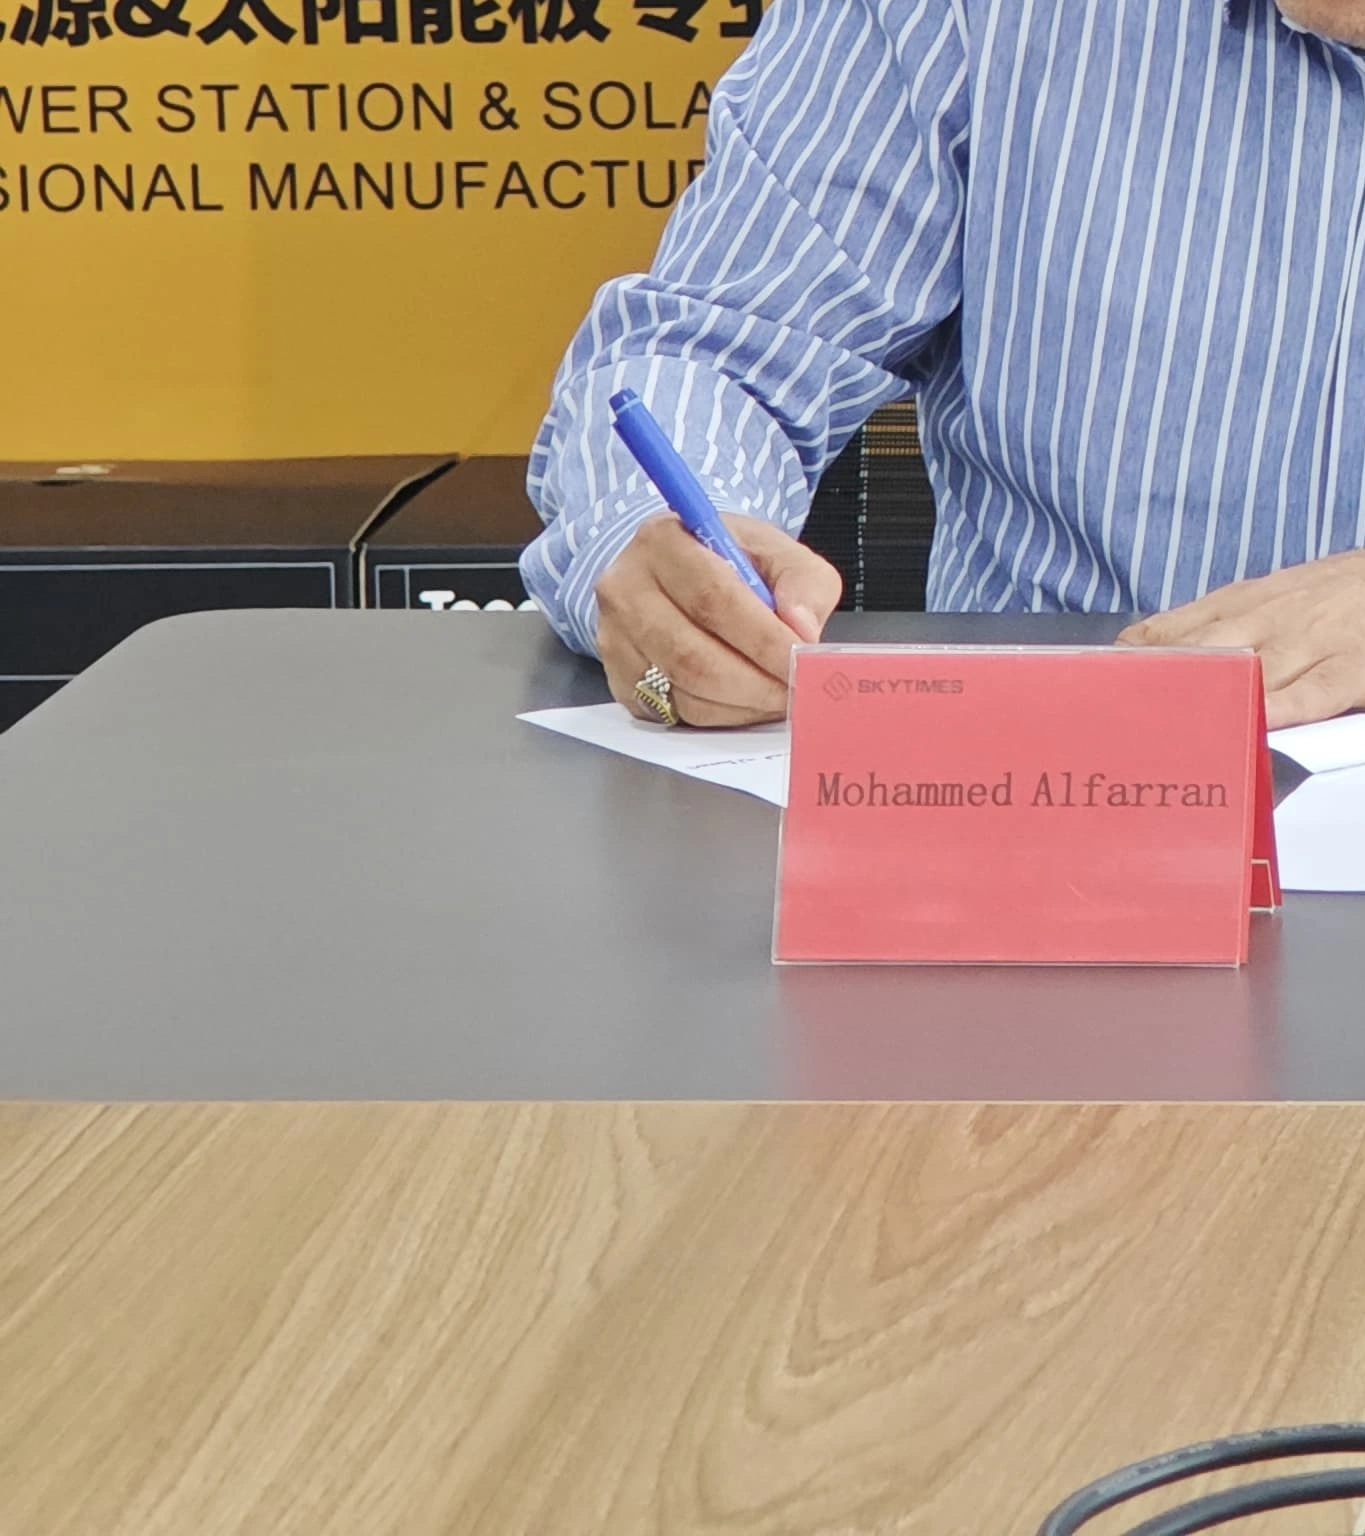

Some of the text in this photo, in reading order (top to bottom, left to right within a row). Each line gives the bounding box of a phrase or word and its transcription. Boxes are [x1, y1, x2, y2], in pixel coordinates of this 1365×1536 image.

[157, 81, 453, 133] STATION
[479, 82, 519, 131] &
[0, 162, 224, 212] IONAL
[857, 679, 964, 694] SKYTIMES
[816, 772, 1229, 808] Mohammed Alfarran
